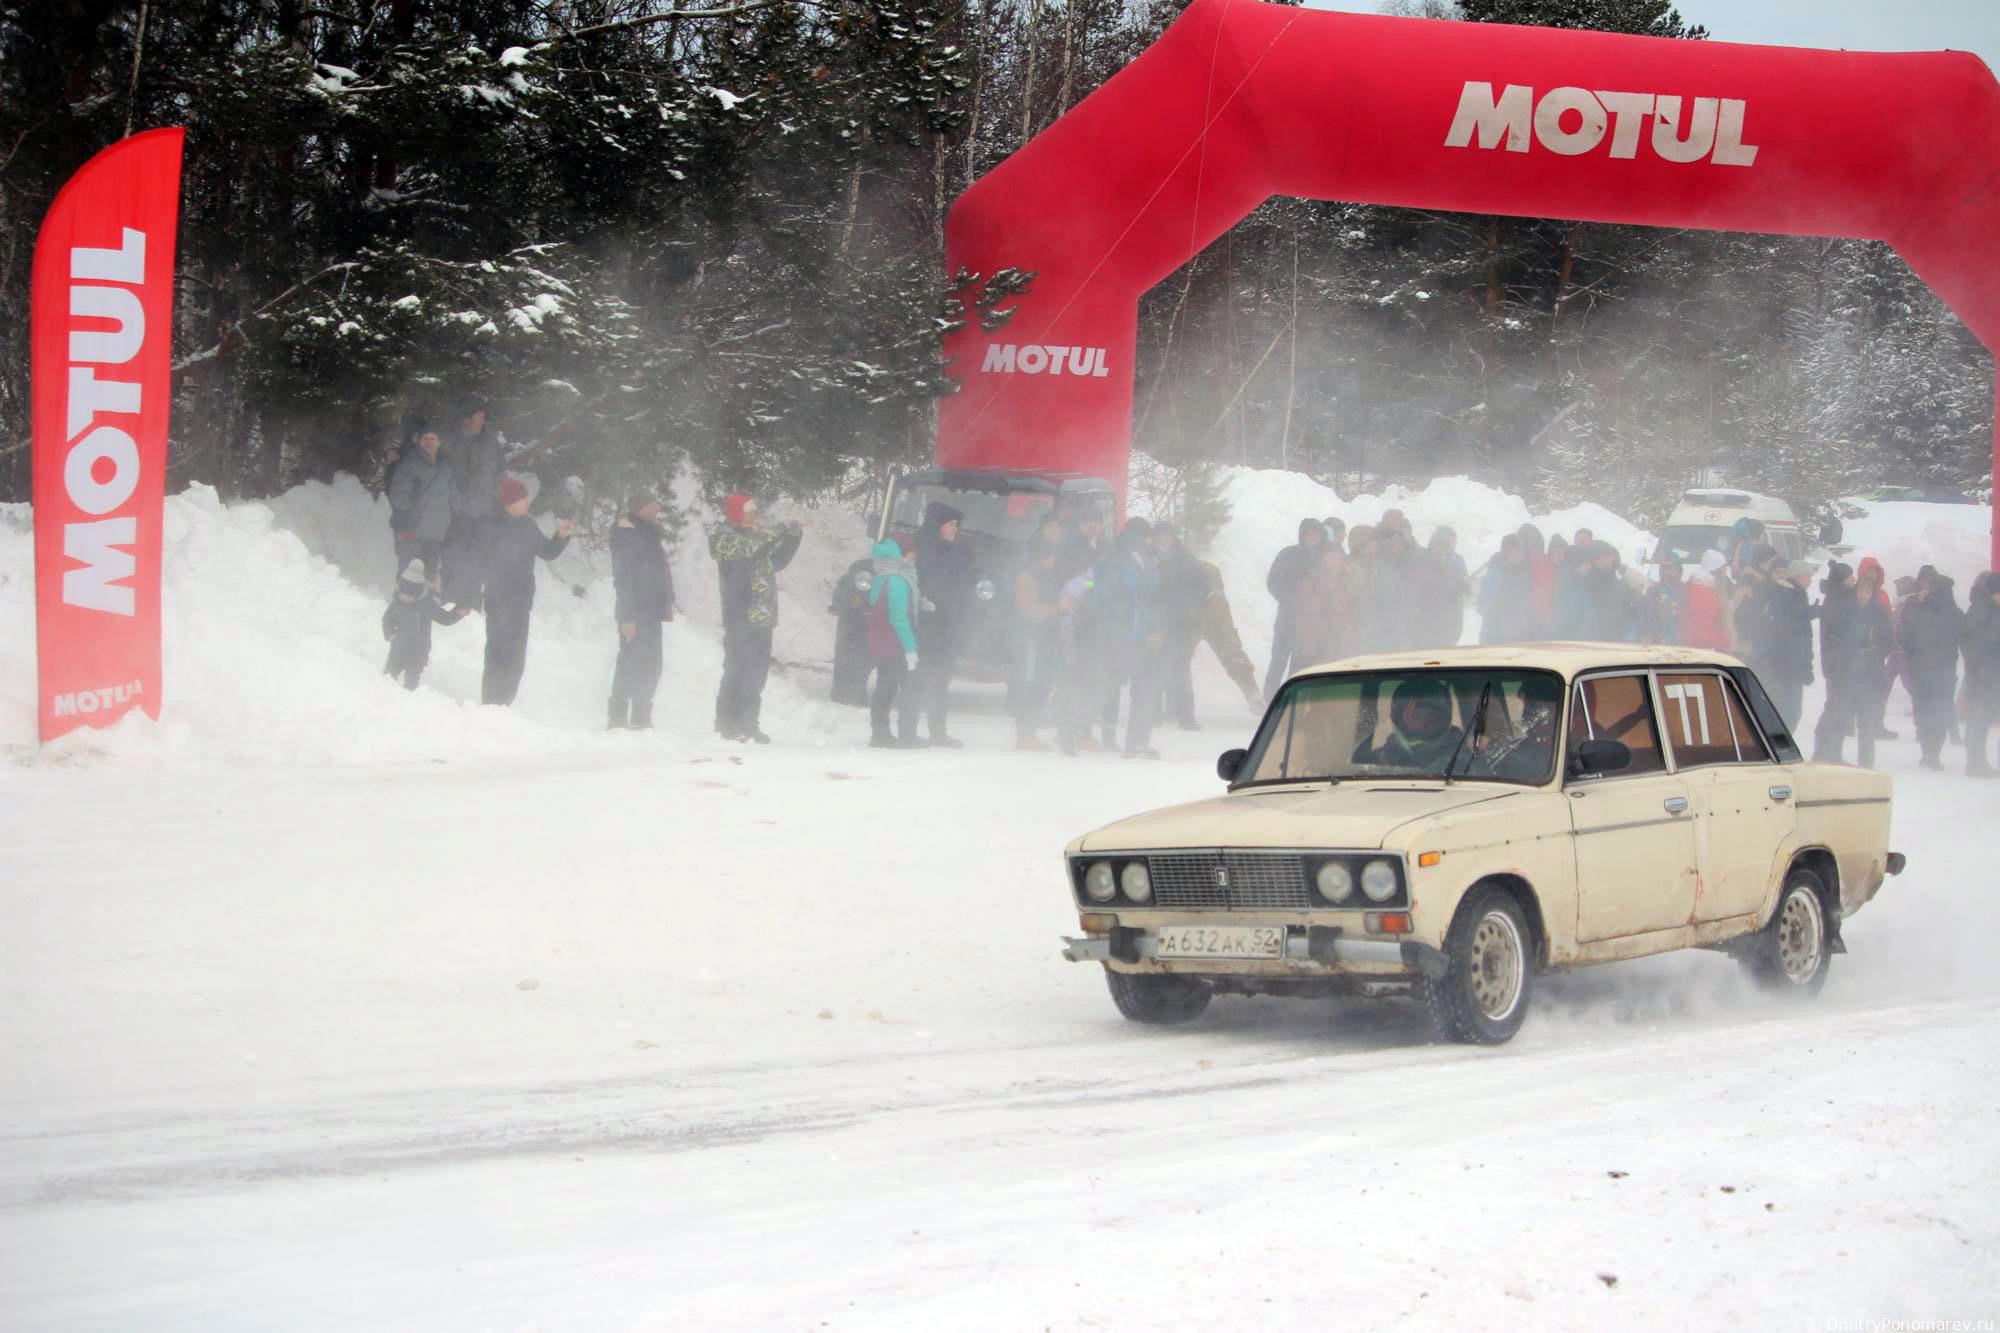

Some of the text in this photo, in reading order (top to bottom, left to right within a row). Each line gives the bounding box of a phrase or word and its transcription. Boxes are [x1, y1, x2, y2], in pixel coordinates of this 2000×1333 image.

[1443, 80, 1759, 167] MOTUL
[981, 343, 1109, 377] MOTUL
[62, 226, 146, 616] MOTUL
